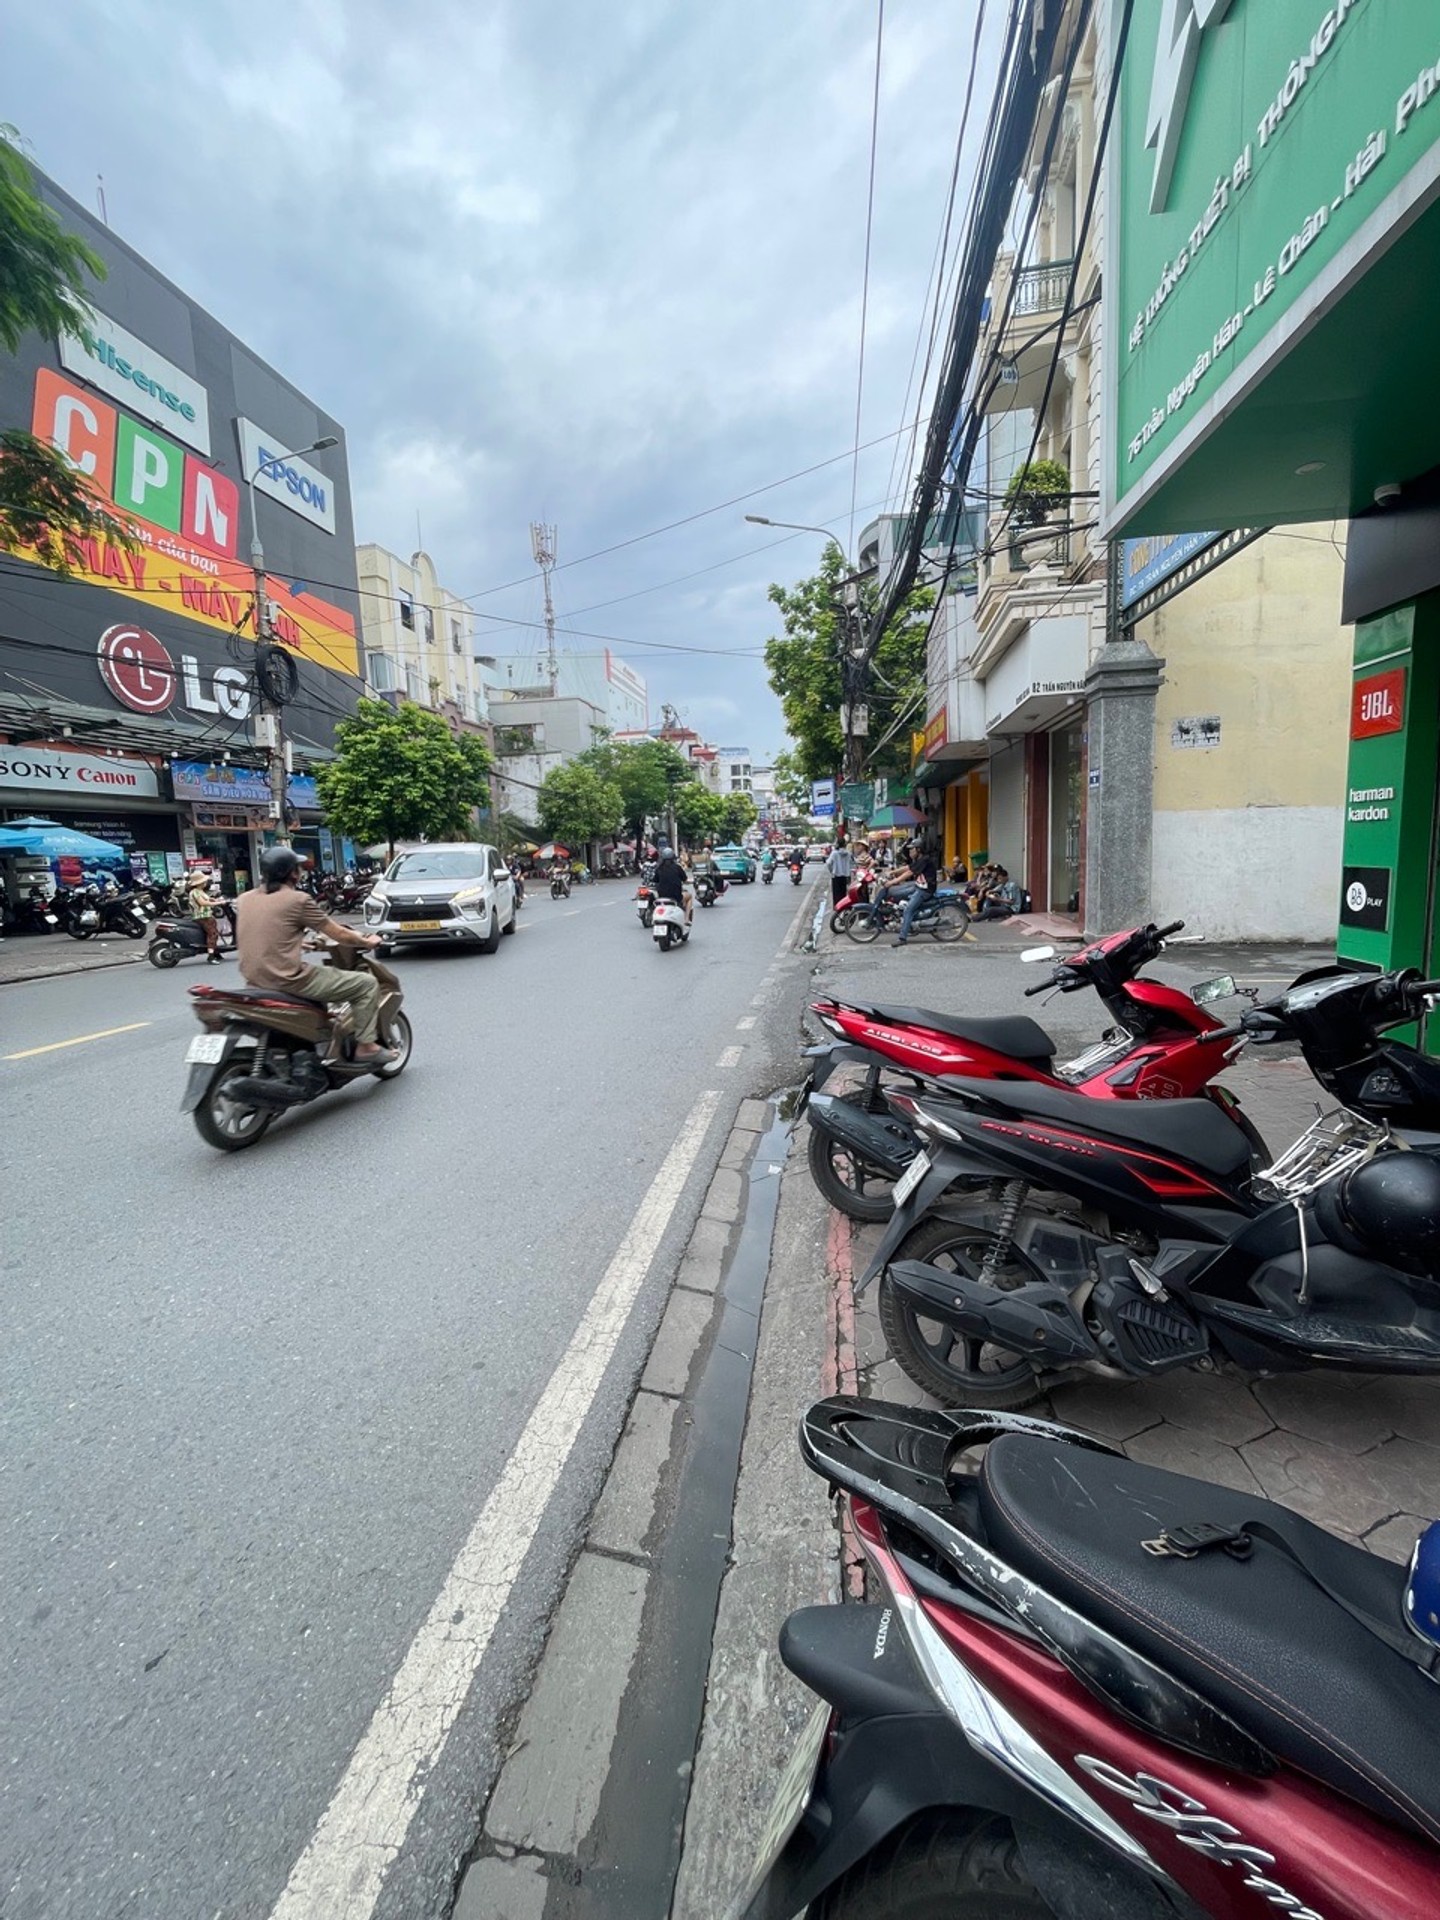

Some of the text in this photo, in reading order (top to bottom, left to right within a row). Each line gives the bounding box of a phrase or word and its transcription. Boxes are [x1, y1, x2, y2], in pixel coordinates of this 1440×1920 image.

[1254, 265, 1276, 306] Lê
[1278, 205, 1329, 276] Chân
[89, 337, 196, 423] Hisense
[53, 394, 228, 548] CPN
[258, 445, 326, 513] EPSON
[181, 654, 251, 720] LG
[1032, 682, 1041, 693] 82
[1361, 689, 1393, 722] JBL
[0, 760, 137, 786] SONY Canon
[1349, 787, 1394, 802] harman
[1348, 805, 1388, 821] kardon
[873, 1607, 893, 1660] HONDA
